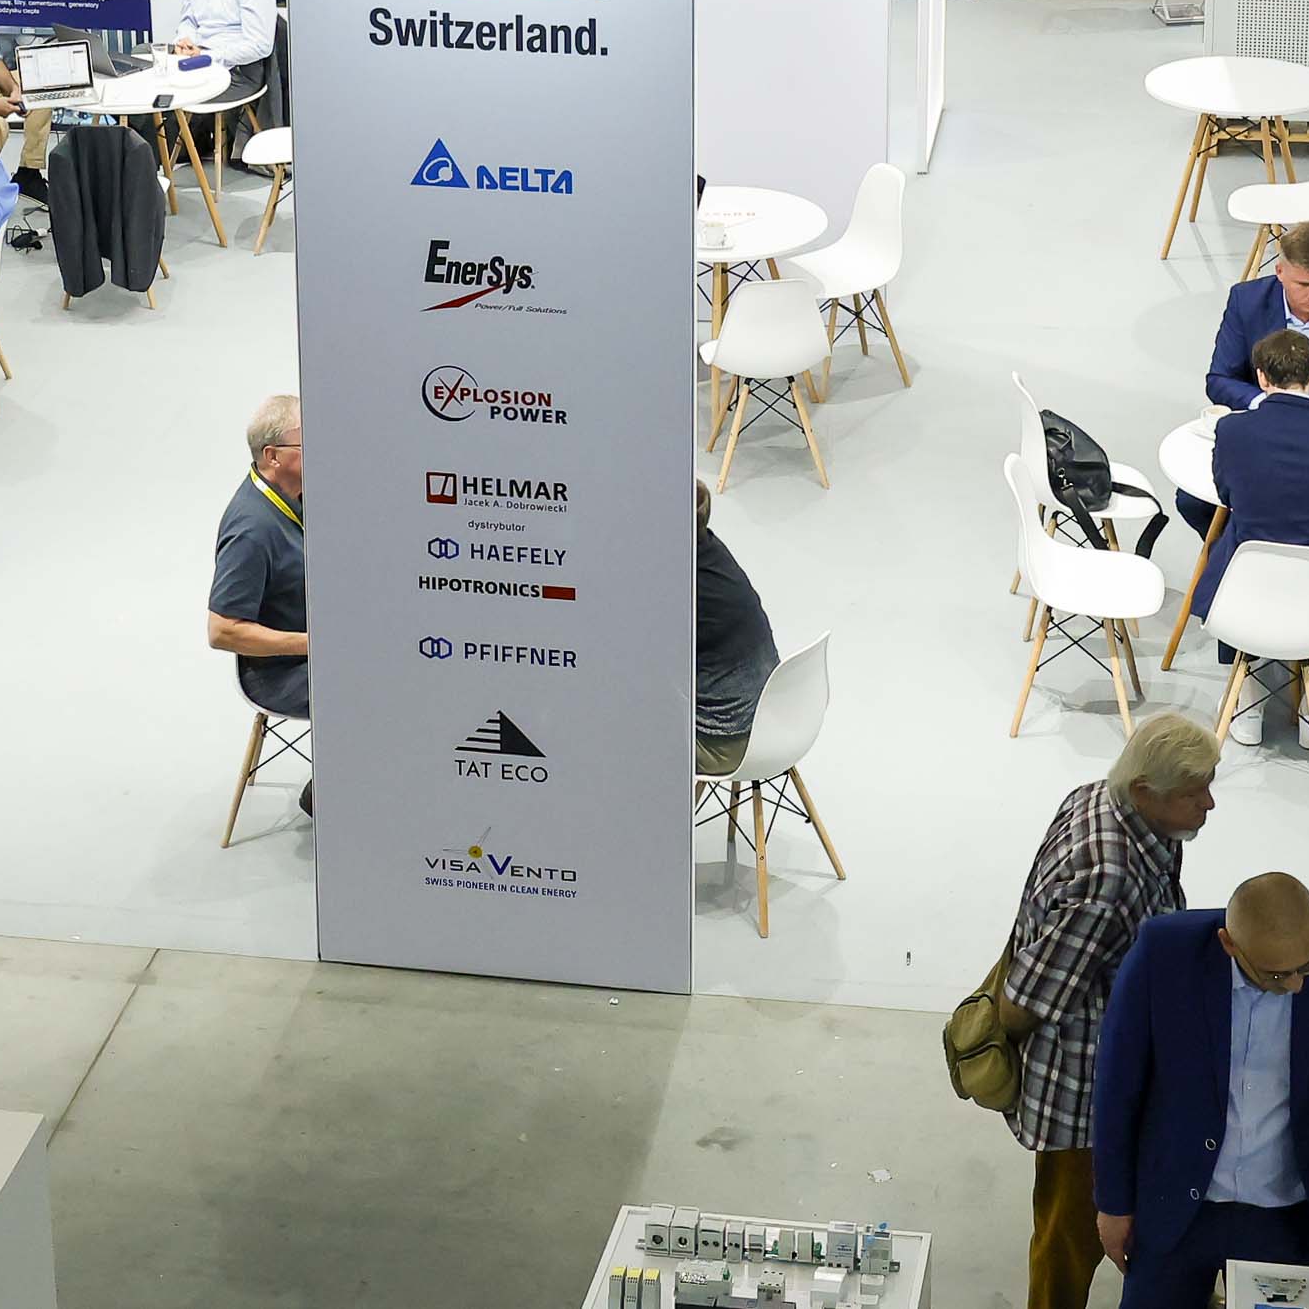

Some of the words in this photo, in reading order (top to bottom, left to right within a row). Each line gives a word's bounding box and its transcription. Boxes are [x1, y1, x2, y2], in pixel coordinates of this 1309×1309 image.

[369, 7, 608, 56] Switzerland.
[476, 165, 573, 195] DELTA
[525, 305, 568, 315] Solutions
[434, 376, 552, 410] EXPLOSION
[490, 406, 568, 425] POWER
[462, 476, 568, 502] HELMAR
[464, 498, 490, 508] Jacek
[493, 501, 503, 509] A.
[506, 501, 567, 513] Dobrowiecki
[468, 520, 525, 532] dystrybutor
[471, 543, 566, 566] HAEFELY
[419, 576, 540, 598] HIPOTRONICS
[464, 642, 577, 668] PFIFFNER
[455, 759, 492, 778] TAT
[501, 764, 548, 783] ECO
[425, 856, 481, 874] VISA
[487, 854, 577, 882] VENTO
[425, 876, 454, 888] SWISS
[456, 879, 495, 892] PIONEER
[497, 883, 508, 893] IN
[510, 884, 539, 895] CLEAN
[541, 887, 577, 899] ENERGY
